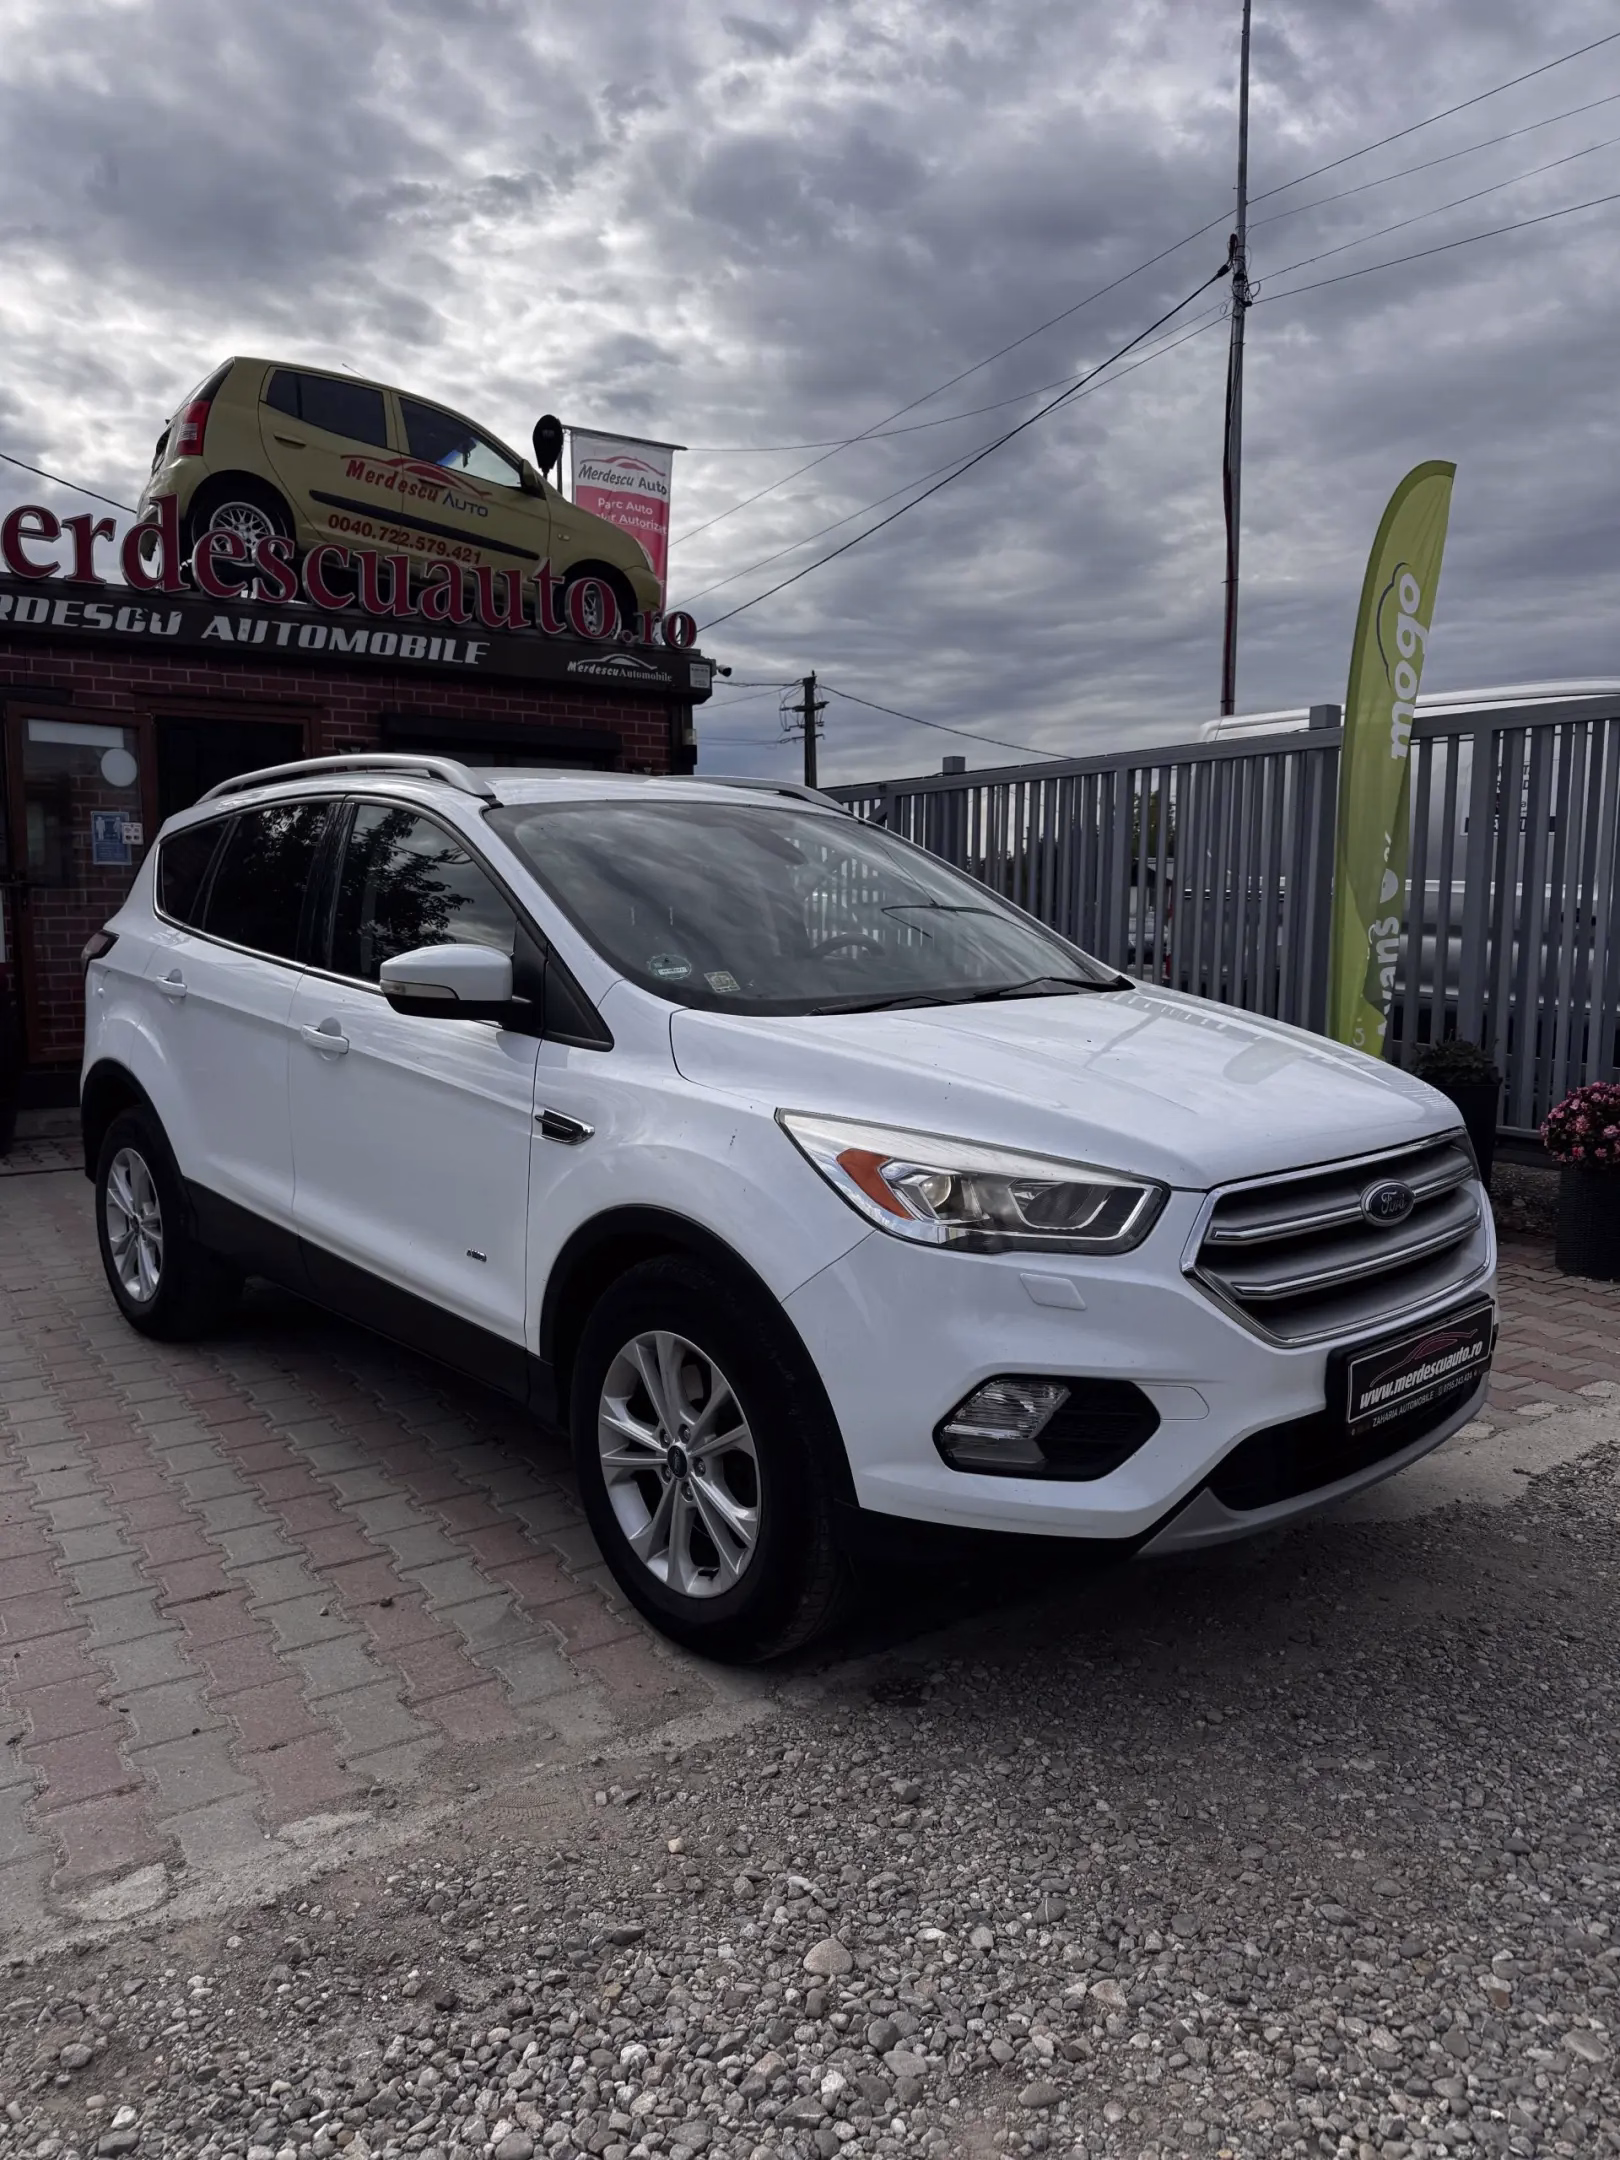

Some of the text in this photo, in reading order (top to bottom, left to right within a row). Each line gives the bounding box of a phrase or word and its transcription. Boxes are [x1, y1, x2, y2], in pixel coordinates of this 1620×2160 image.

[345, 460, 439, 502] Merdescu
[578, 464, 667, 495] Merdescu Auto
[598, 498, 653, 515] Parc Auto
[328, 514, 481, 564] 0040.722.579.421
[201, 615, 490, 666] AUTOMOBILE
[1391, 572, 1429, 759] mogo
[1381, 1191, 1406, 1214] Ford
[1360, 1341, 1483, 1409] www.merdescuauto.ro
[1372, 1407, 1398, 1428] ZAHARIA
[1398, 1390, 1434, 1415] AUTOMOBILE
